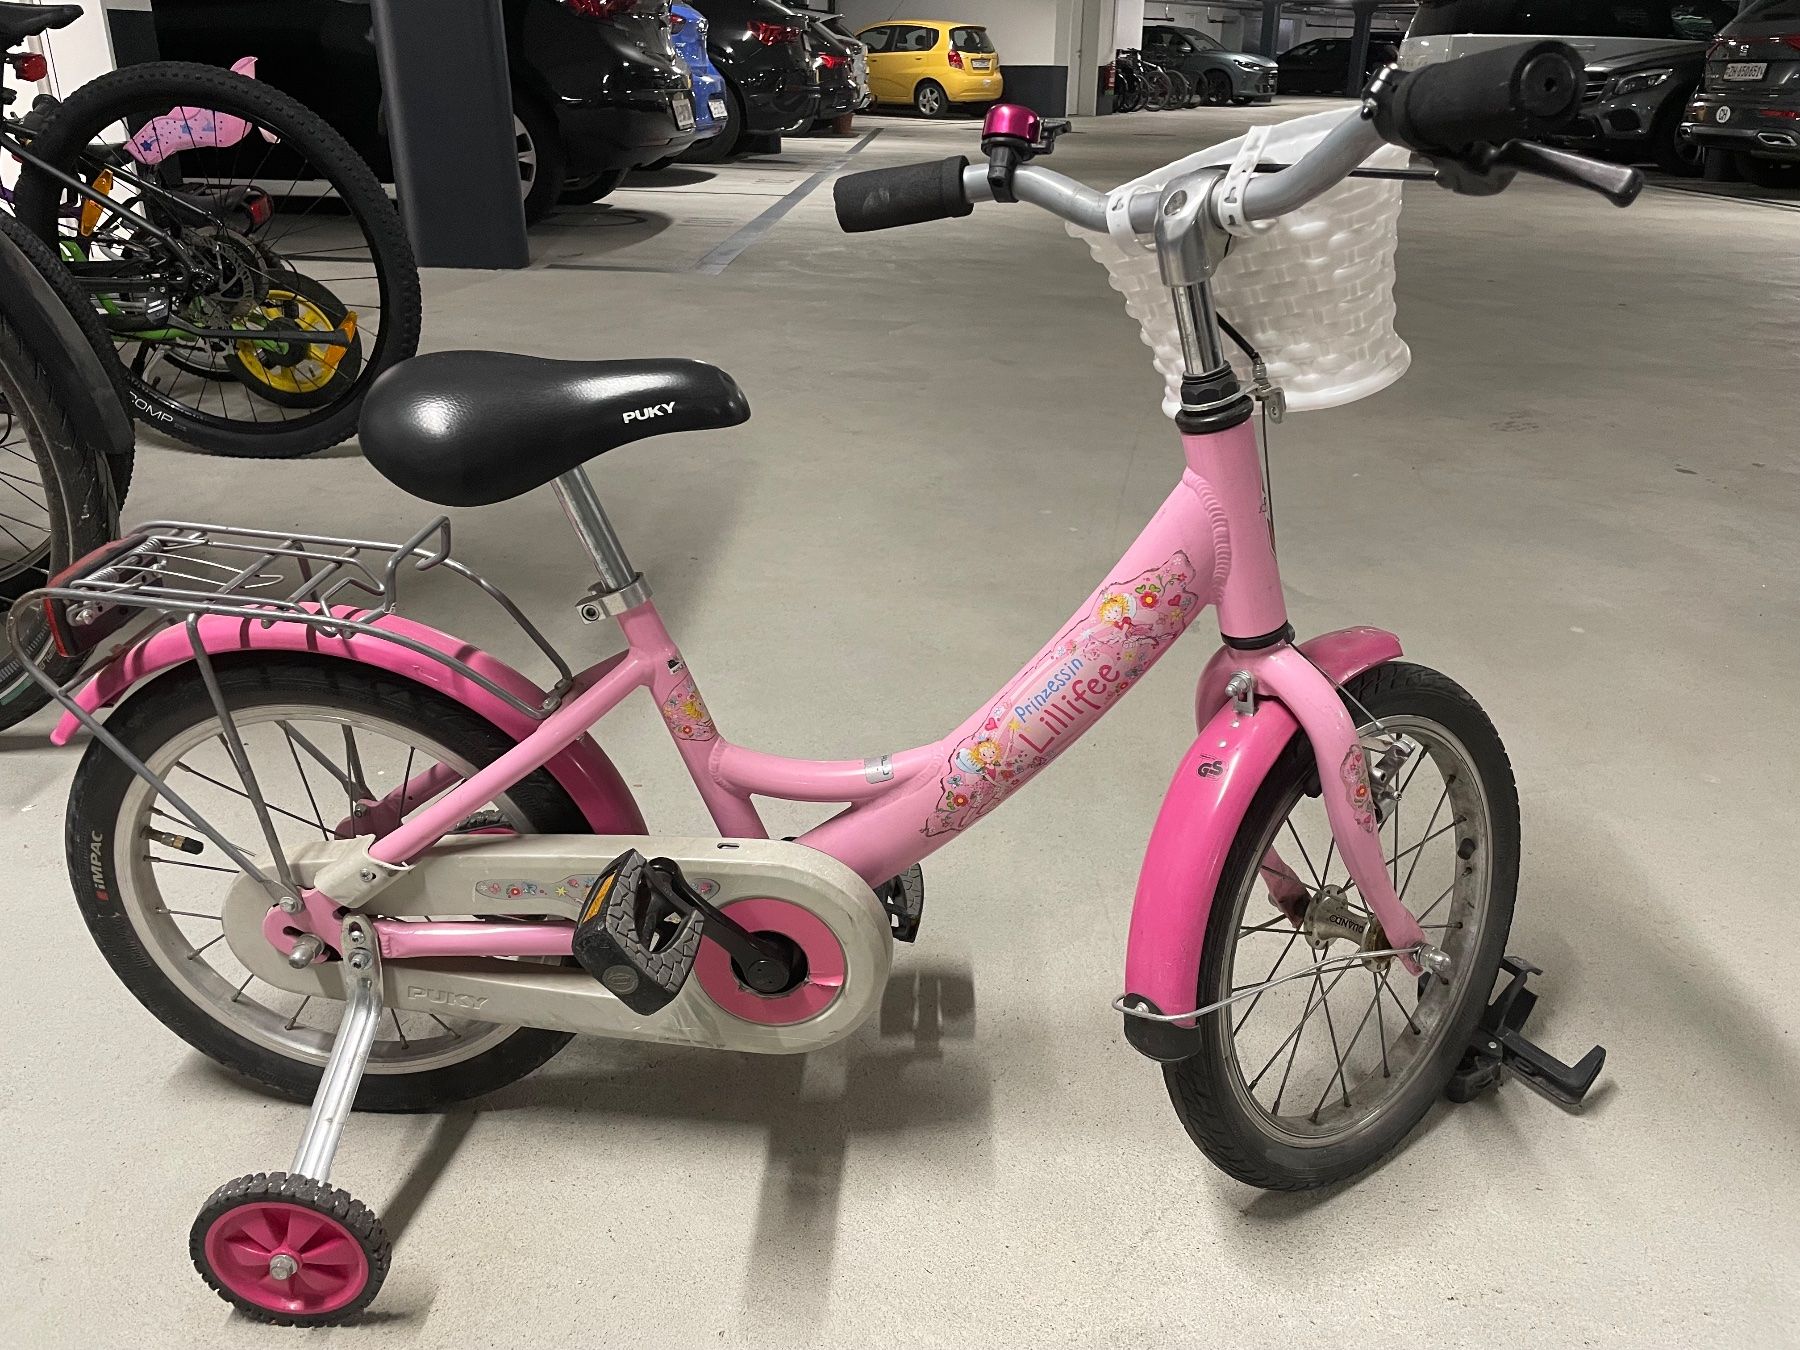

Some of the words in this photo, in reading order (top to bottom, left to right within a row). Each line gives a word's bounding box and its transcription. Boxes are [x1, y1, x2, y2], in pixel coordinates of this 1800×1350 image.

[622, 401, 676, 424] PUKY
[1018, 664, 1121, 754] Lillifee
[407, 985, 489, 1010] PUKY
